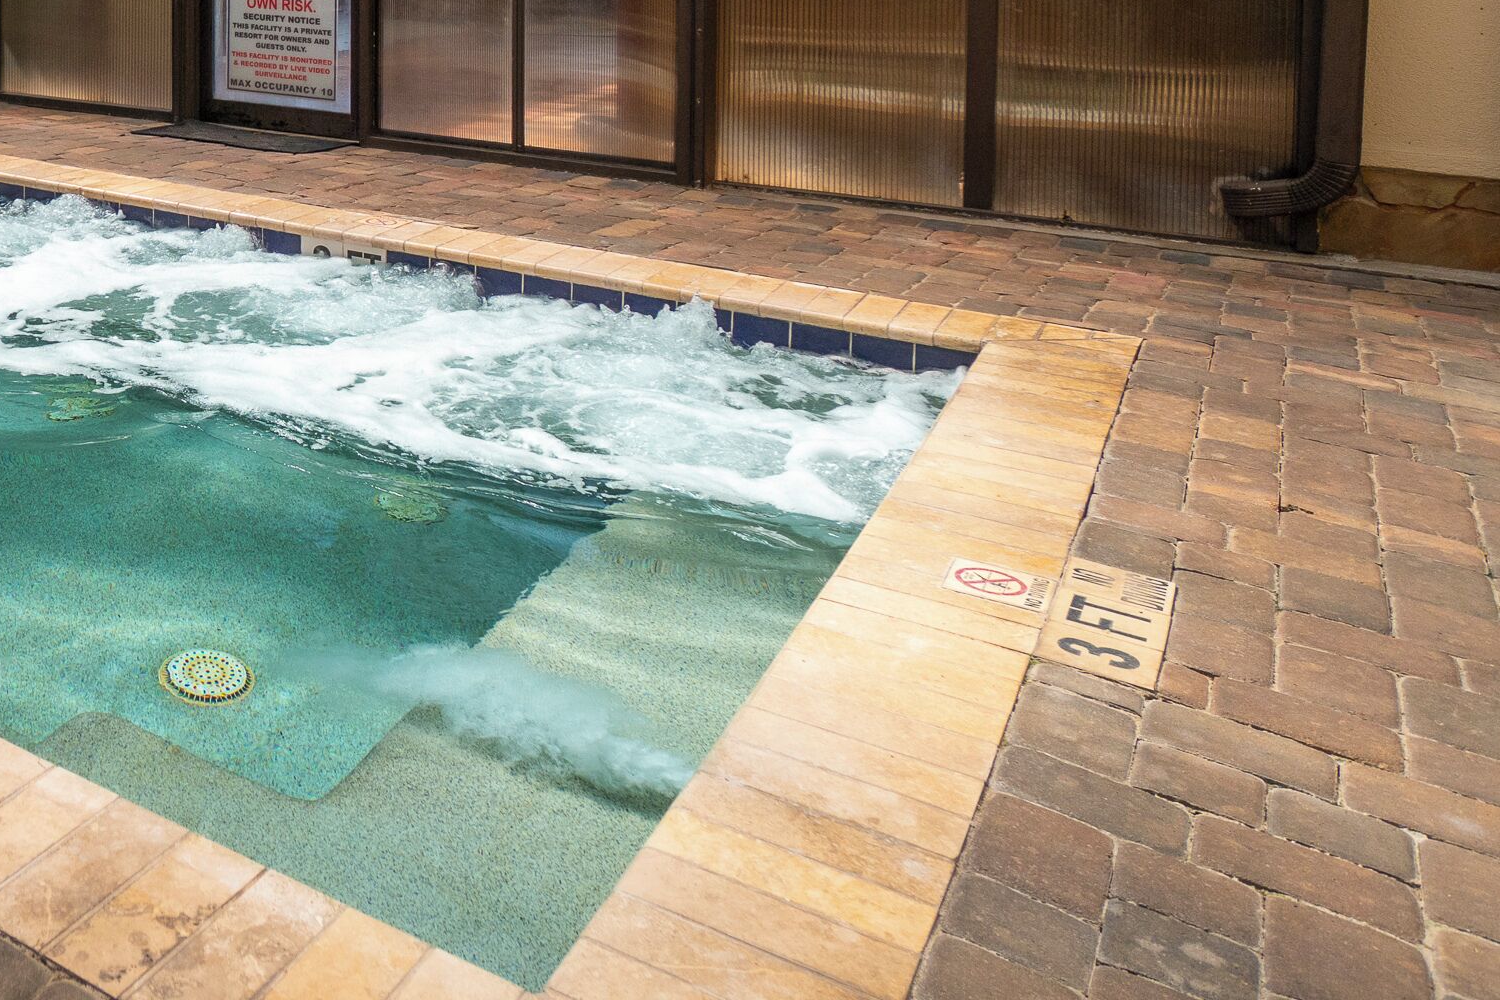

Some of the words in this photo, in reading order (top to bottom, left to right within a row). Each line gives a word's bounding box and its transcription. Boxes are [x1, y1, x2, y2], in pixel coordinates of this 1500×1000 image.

[243, 12, 285, 23] SECURITY
[288, 15, 321, 25] NOTICE
[250, 24, 282, 32] FACILITY
[300, 28, 332, 36] PRIVATE
[234, 31, 263, 40] RESORT
[280, 35, 312, 44] OWNERS
[314, 38, 330, 46] AND
[255, 42, 285, 51] GUESTS
[286, 44, 308, 53] ONLY.
[231, 50, 248, 58] THIS
[248, 52, 281, 61] FACILITY
[289, 56, 333, 66] MONITORED
[240, 60, 277, 70] RECORDED
[290, 65, 307, 73] LIVE
[307, 66, 331, 75] VIDEO
[254, 70, 308, 82] SURVEILLANCE
[230, 78, 252, 88] MAX
[254, 81, 317, 95] OCCUPANCY
[321, 88, 333, 97] 10
[1071, 567, 1116, 589] NO
[1028, 577, 1051, 605] DIVING
[1121, 573, 1169, 612] DIVING
[1024, 598, 1042, 609] NO
[1066, 594, 1152, 643] FT
[1057, 636, 1141, 670] 3
